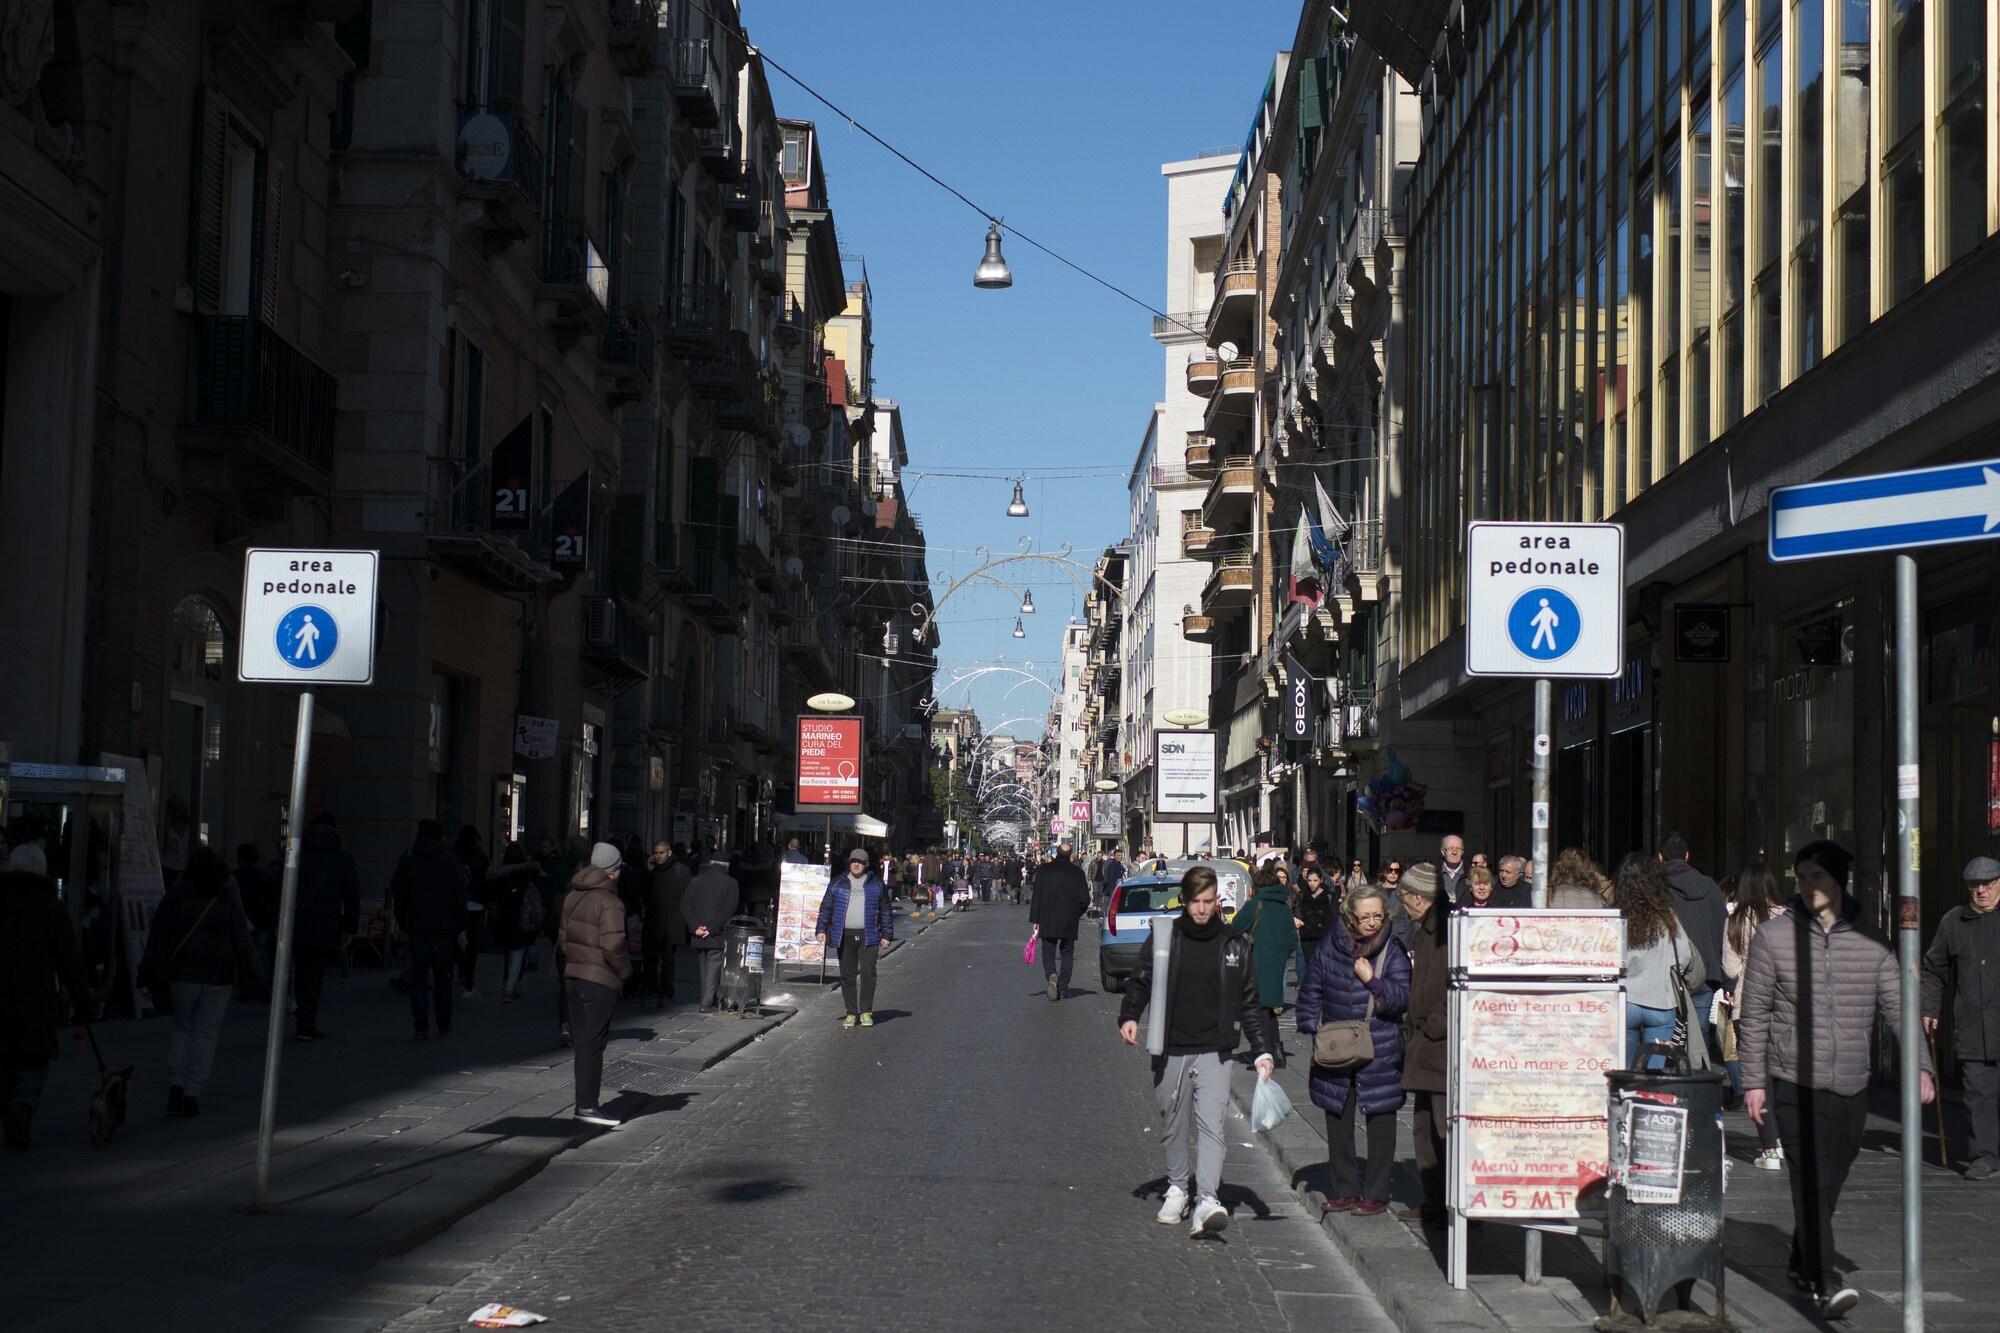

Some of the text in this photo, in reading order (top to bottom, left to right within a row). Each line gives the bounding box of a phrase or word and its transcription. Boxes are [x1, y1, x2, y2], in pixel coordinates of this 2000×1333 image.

[495, 488, 527, 512] 21
[555, 534, 584, 555] 21
[1519, 536, 1571, 549] area
[289, 560, 333, 572] area
[1490, 557, 1600, 577] pedonale
[263, 579, 357, 595] pedonale
[1295, 678, 1306, 735] GEOX
[801, 724, 833, 732] STUDIO
[801, 732, 843, 740] MARINEO
[801, 740, 843, 748] CURA DEL
[1161, 744, 1185, 753] SDN
[801, 748, 826, 756] PIEDE
[1490, 916, 1520, 958] 3
[1472, 999, 1611, 1013] Menù terra 15€
[1471, 1056, 1612, 1070] Menù mare 20€
[1650, 1114, 1677, 1126] ASD
[1471, 1159, 1518, 1173] Menù
[1524, 1162, 1569, 1173] mare
[1470, 1190, 1573, 1210] A 5 MT
